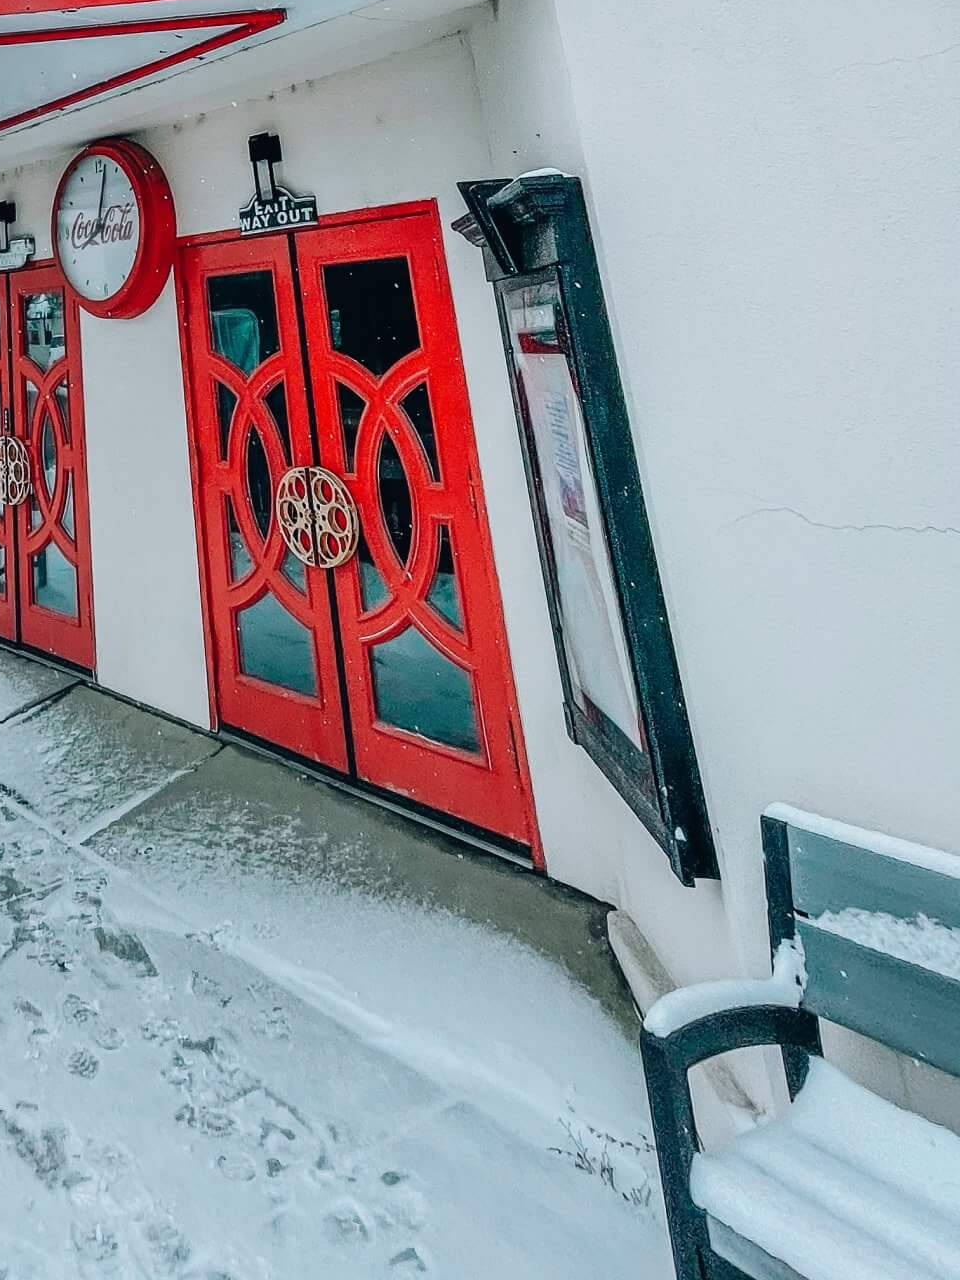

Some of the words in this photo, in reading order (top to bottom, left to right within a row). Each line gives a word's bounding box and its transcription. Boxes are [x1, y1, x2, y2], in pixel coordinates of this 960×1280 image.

[71, 202, 134, 250] CocaCola
[240, 214, 270, 231] WAY
[277, 208, 313, 225] OUT
